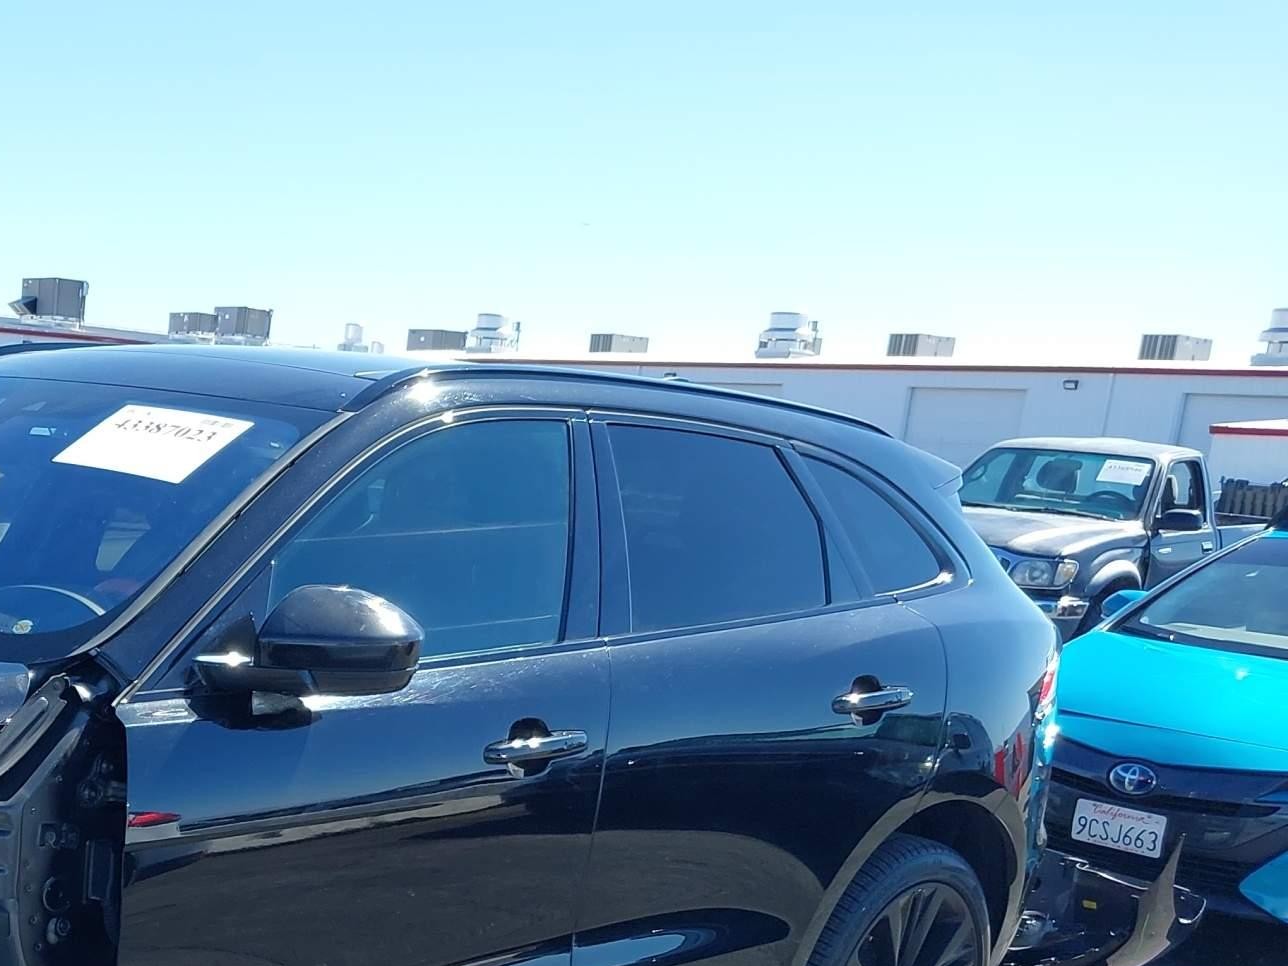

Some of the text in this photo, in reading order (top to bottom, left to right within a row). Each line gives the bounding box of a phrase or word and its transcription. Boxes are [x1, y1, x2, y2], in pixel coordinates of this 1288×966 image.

[115, 419, 217, 442] 43387023
[1093, 804, 1150, 824] California
[1076, 815, 1158, 852] 9CSJ663
